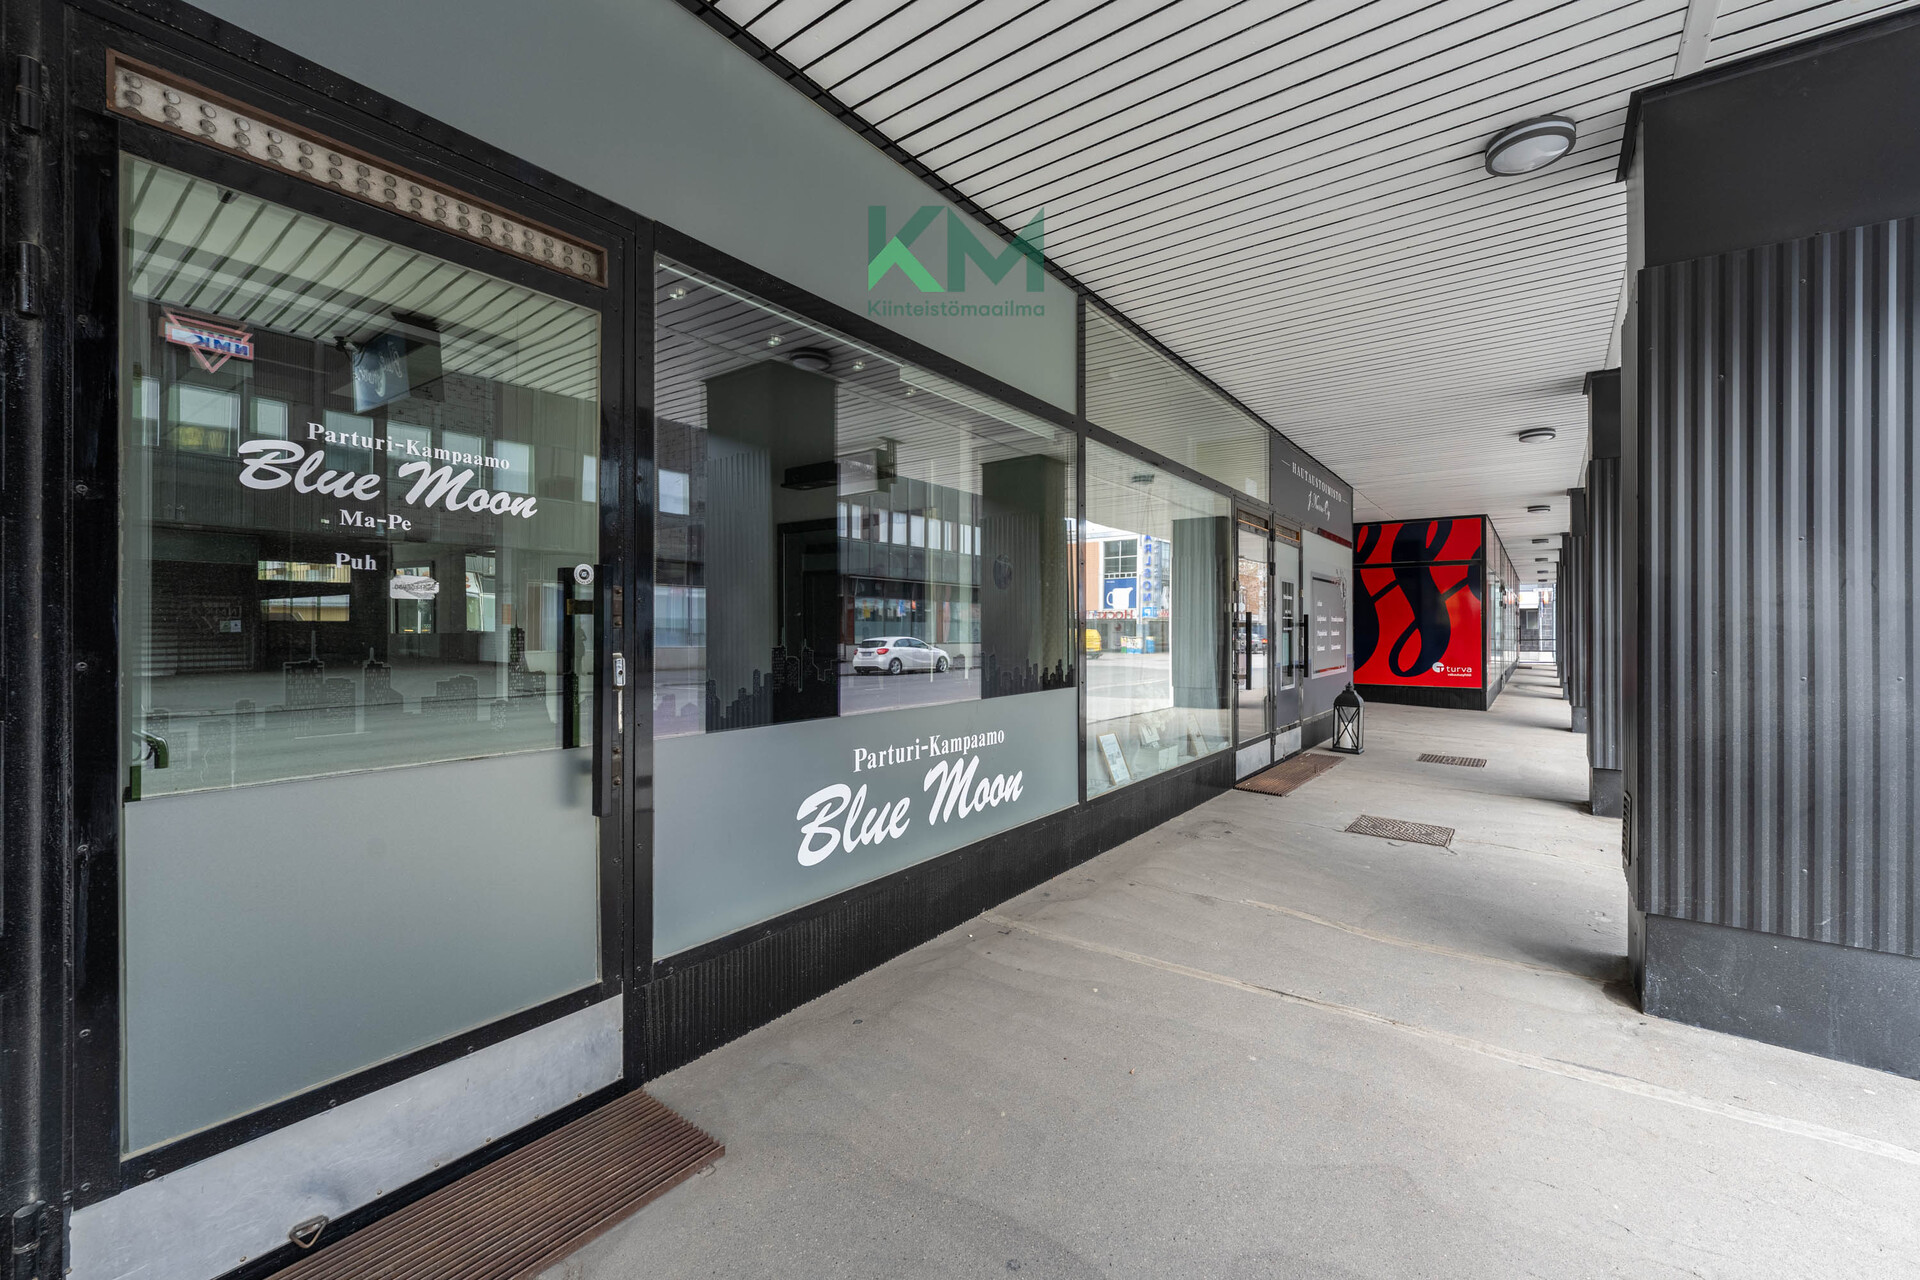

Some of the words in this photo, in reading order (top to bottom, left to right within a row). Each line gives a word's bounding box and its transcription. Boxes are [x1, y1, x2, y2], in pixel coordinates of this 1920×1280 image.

[307, 422, 510, 470] Parturi-Kampaamo
[238, 439, 381, 501] Blue
[398, 460, 538, 519] Moon
[339, 508, 412, 531] Ma-Pe
[334, 552, 378, 571] Puh
[1446, 665, 1472, 673] turva
[853, 729, 1005, 773] Parturi-Kampaamo
[796, 783, 911, 867] Blue
[923, 755, 1024, 825] Moon
